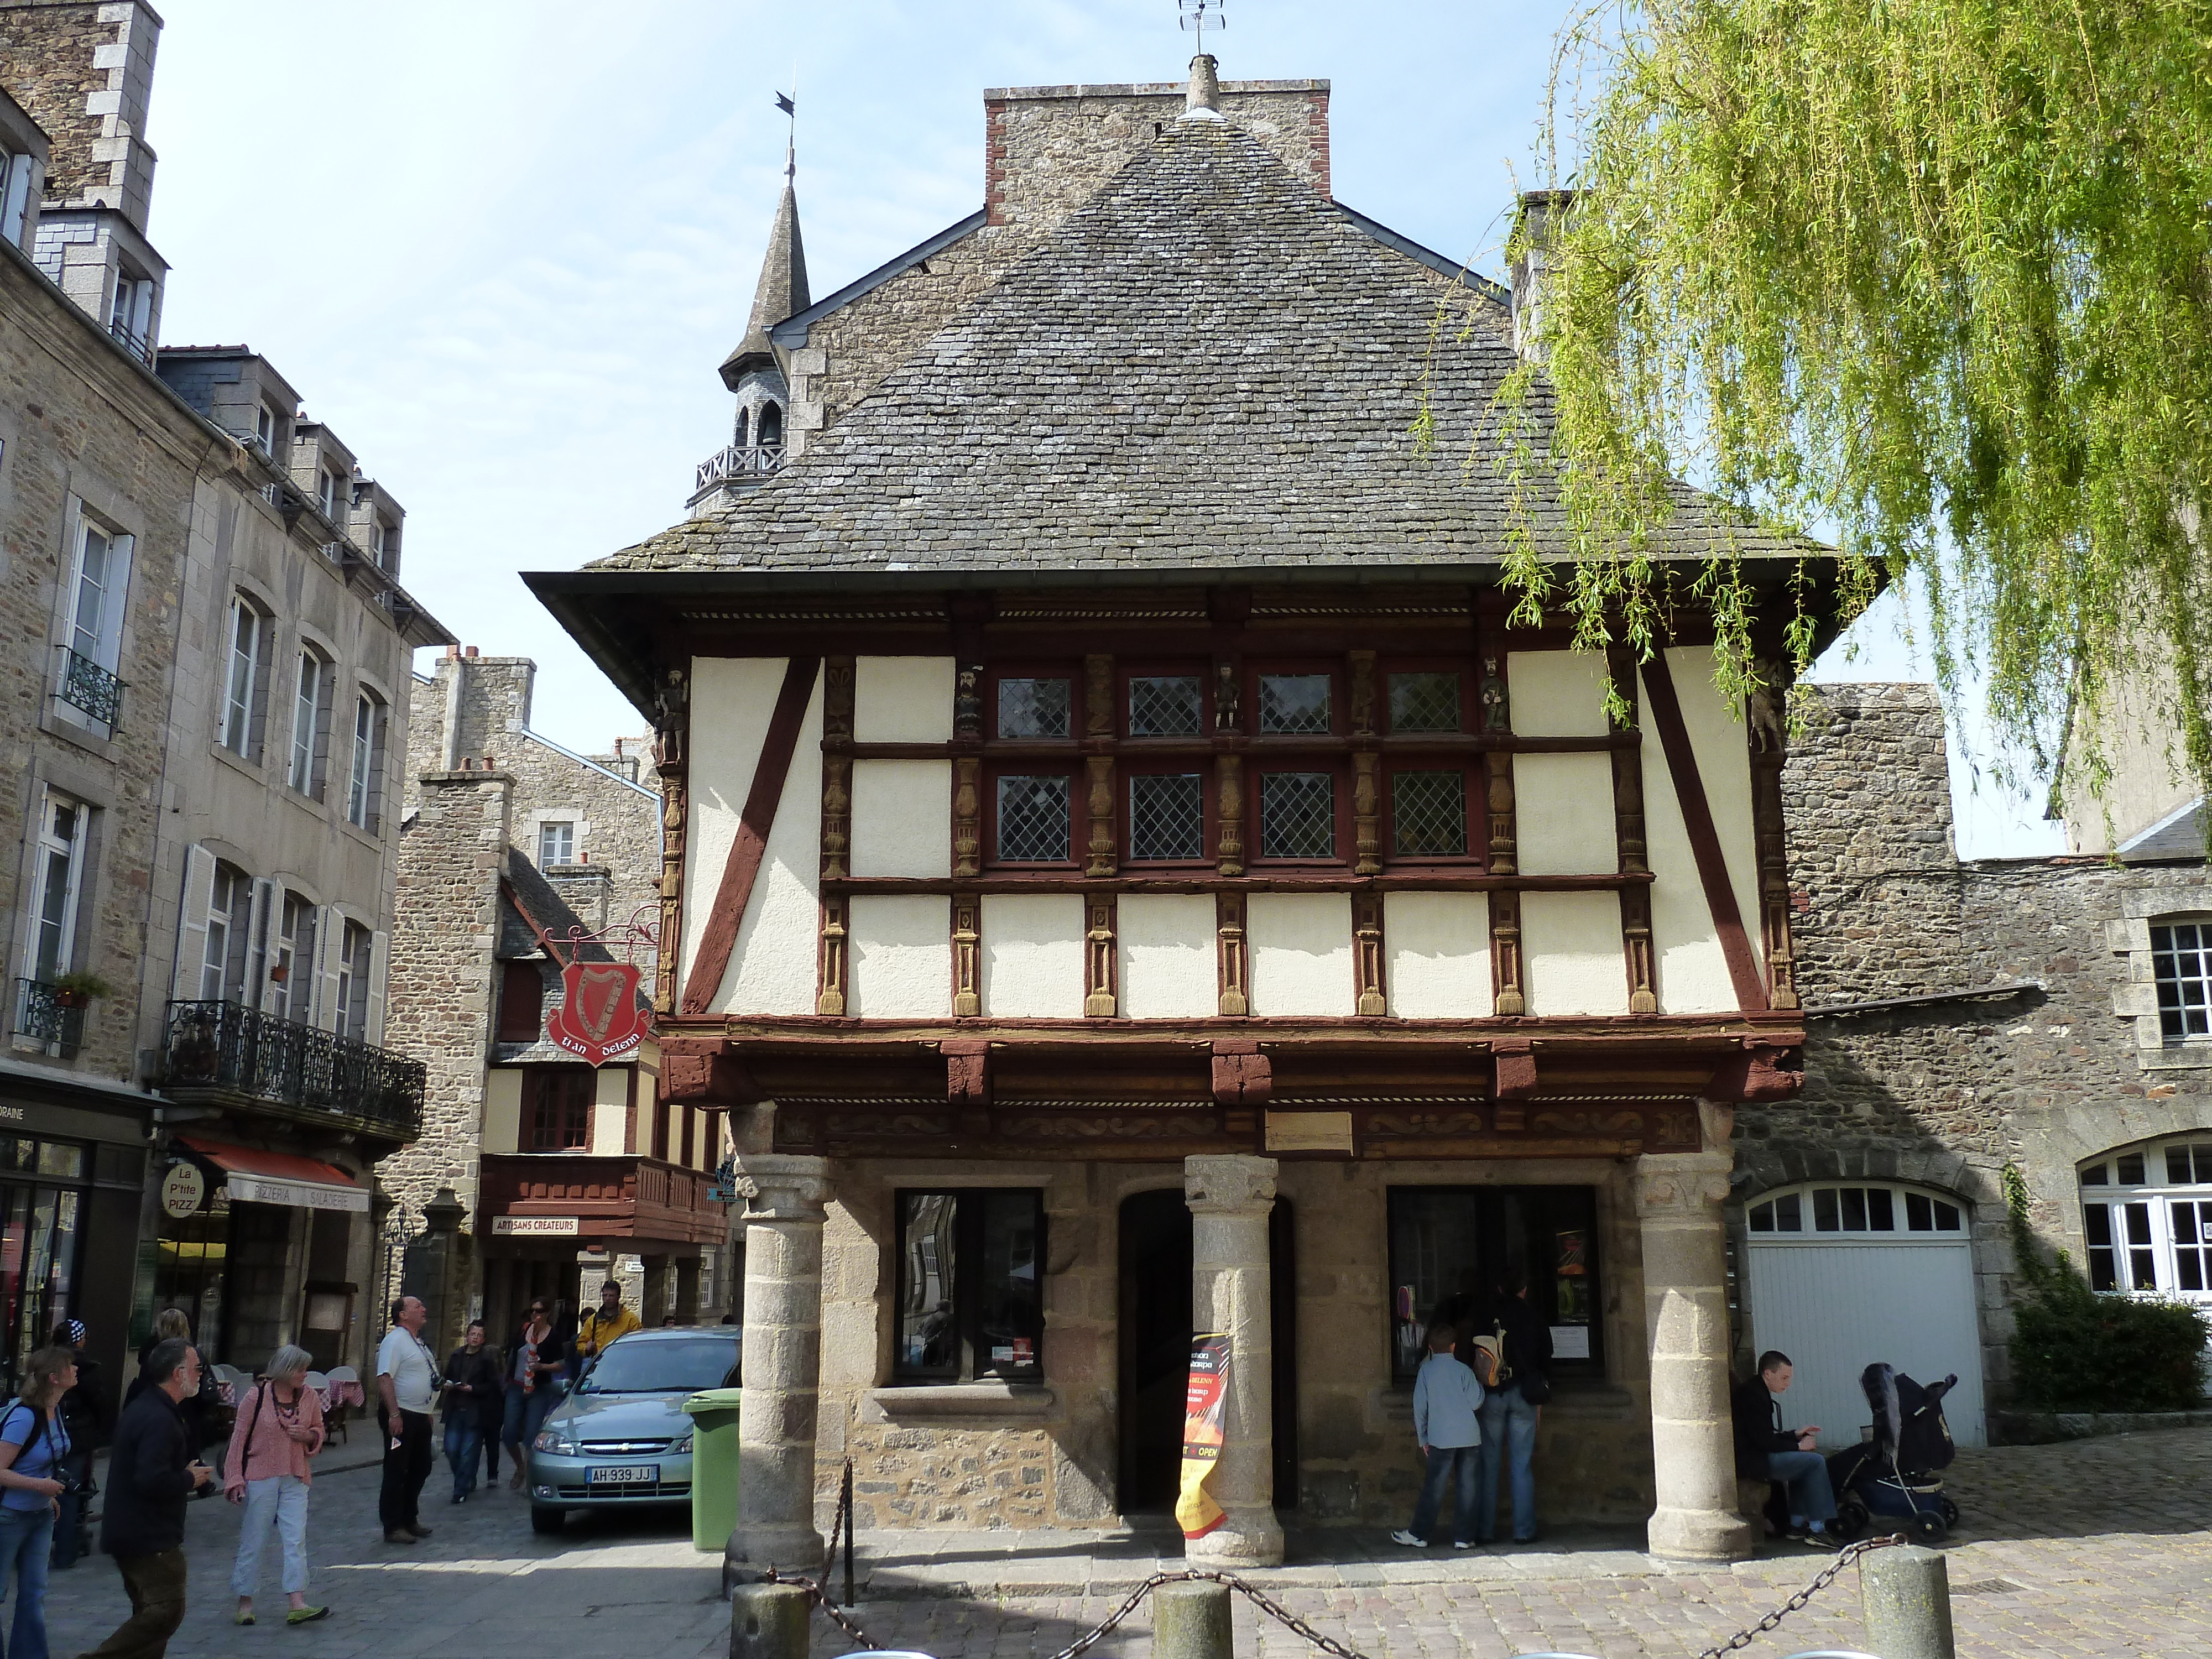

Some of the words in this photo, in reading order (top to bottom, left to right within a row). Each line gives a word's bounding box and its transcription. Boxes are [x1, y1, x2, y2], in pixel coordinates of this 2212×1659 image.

[571, 1042, 587, 1055] an
[602, 1033, 640, 1056] delenn
[179, 1168, 191, 1178] La
[170, 1183, 196, 1194] P'tite
[168, 1199, 196, 1210] PIZZ'
[497, 1220, 532, 1230] ARTISANS
[1198, 1447, 1218, 1457] OPEN
